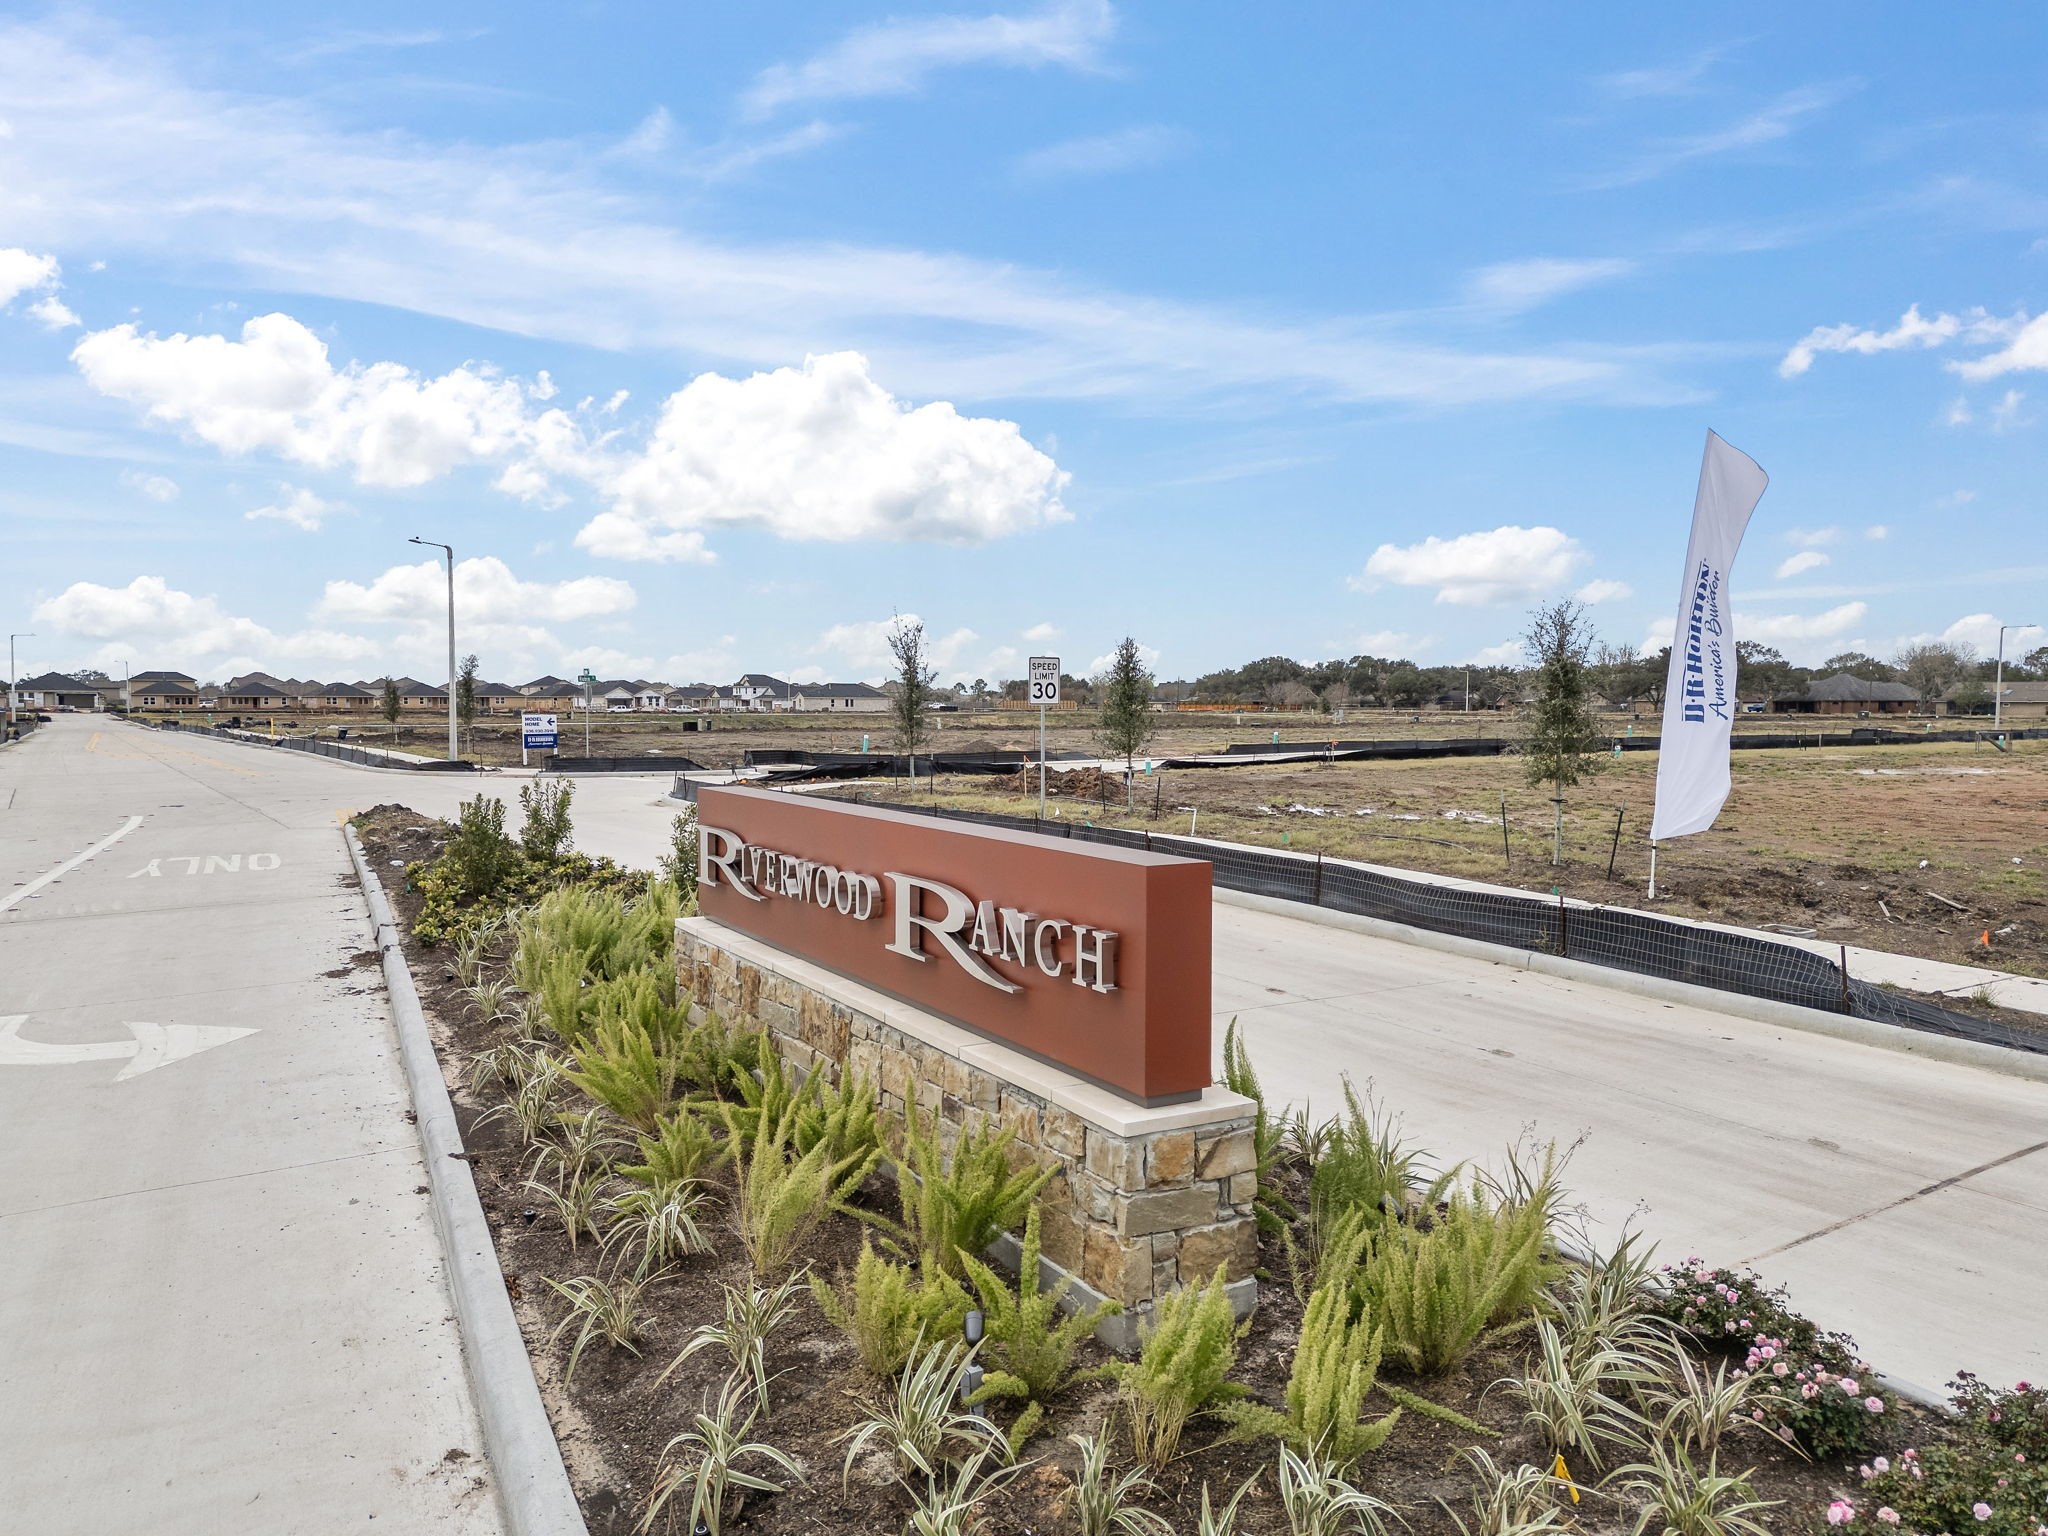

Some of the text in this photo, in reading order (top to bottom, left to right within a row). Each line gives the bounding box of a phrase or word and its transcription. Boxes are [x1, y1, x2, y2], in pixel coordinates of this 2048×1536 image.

[1031, 662, 1058, 671] SPEED
[1034, 672, 1055, 680] LIMIT
[1032, 682, 1057, 699] 30
[1708, 641, 1729, 720] America's
[126, 852, 282, 879] ONLY
[696, 824, 1120, 995] RIVERWOOD RANCH
